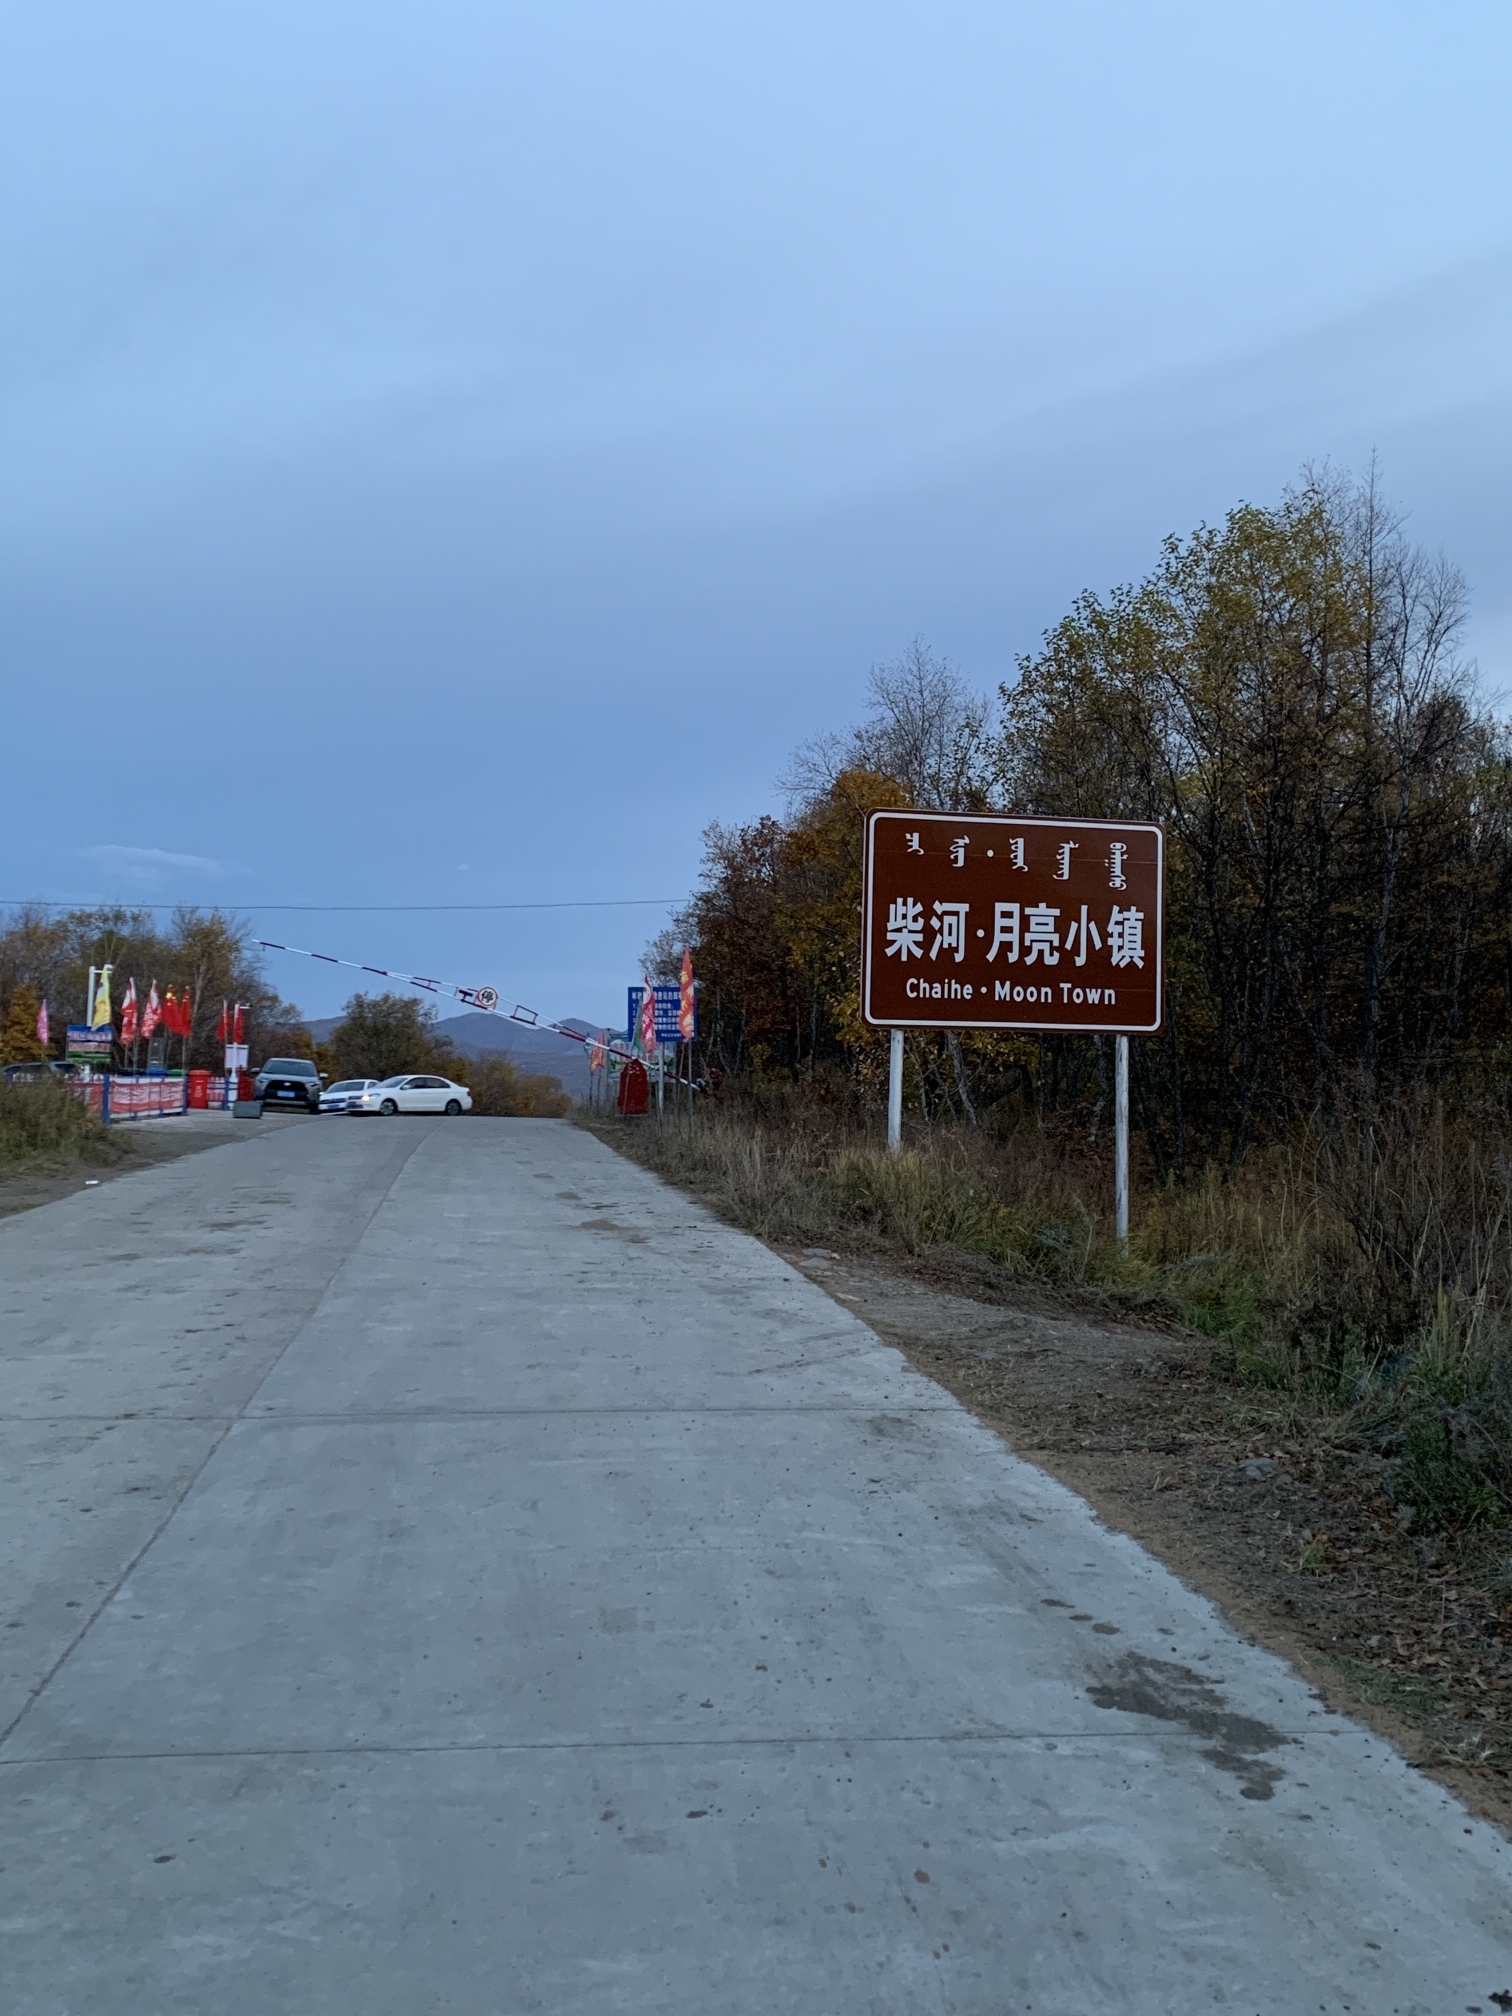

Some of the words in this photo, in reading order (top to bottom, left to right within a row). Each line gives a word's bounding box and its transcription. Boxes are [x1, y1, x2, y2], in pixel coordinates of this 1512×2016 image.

[884, 897, 1145, 969] 柴河·月亮小镇
[481, 990, 494, 1003] 停
[906, 978, 973, 999] Chaihe
[994, 980, 1052, 1003] Moon
[1059, 982, 1116, 1005] Town
